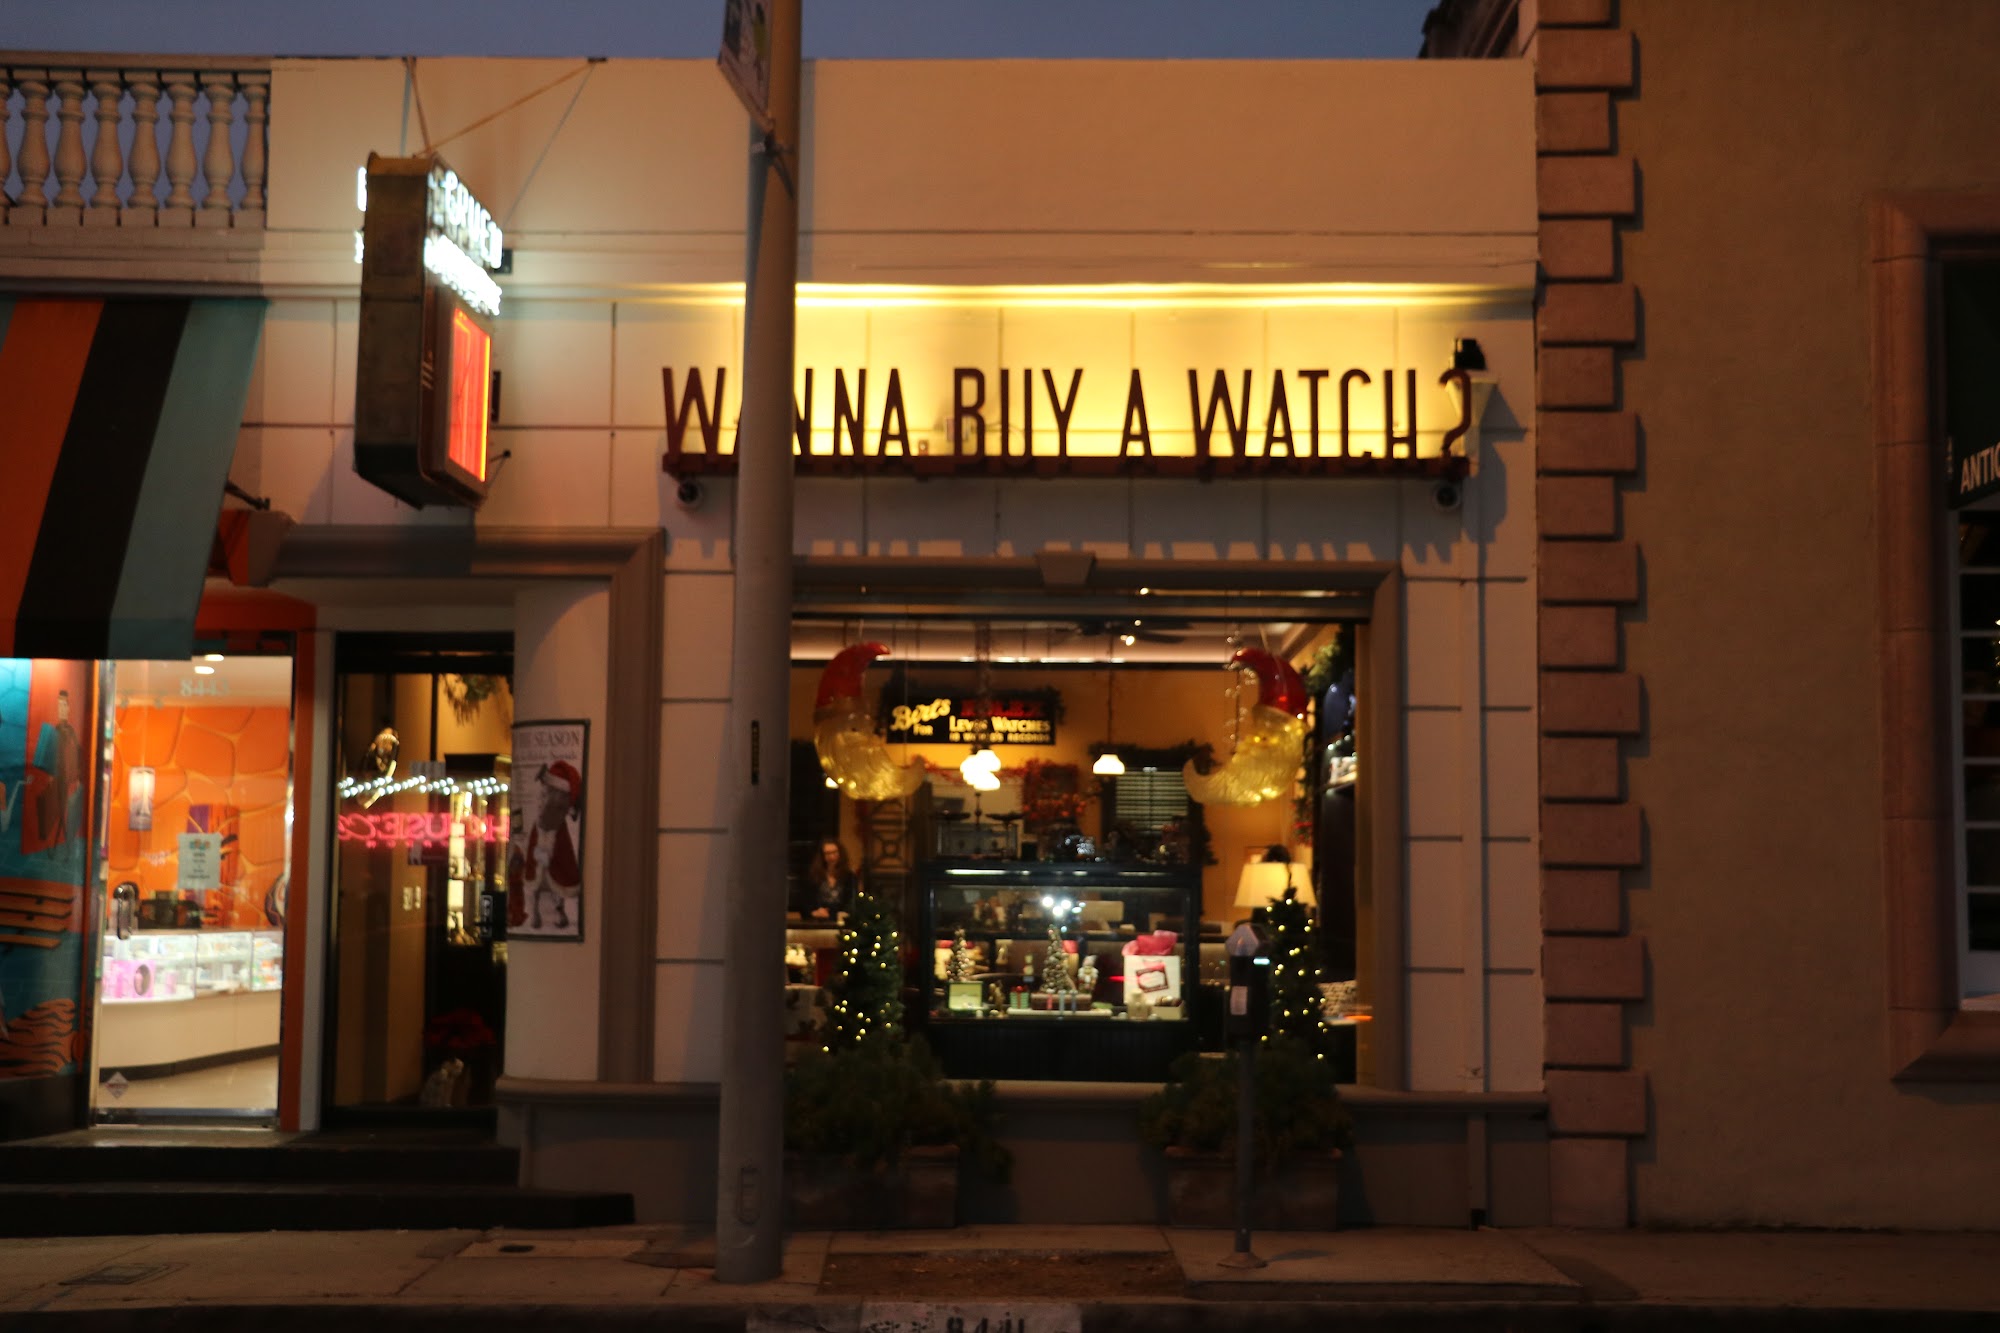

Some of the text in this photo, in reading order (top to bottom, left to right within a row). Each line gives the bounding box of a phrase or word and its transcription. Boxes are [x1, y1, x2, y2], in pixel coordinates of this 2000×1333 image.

[662, 366, 1473, 459] WNNA BUY A WATCH?
